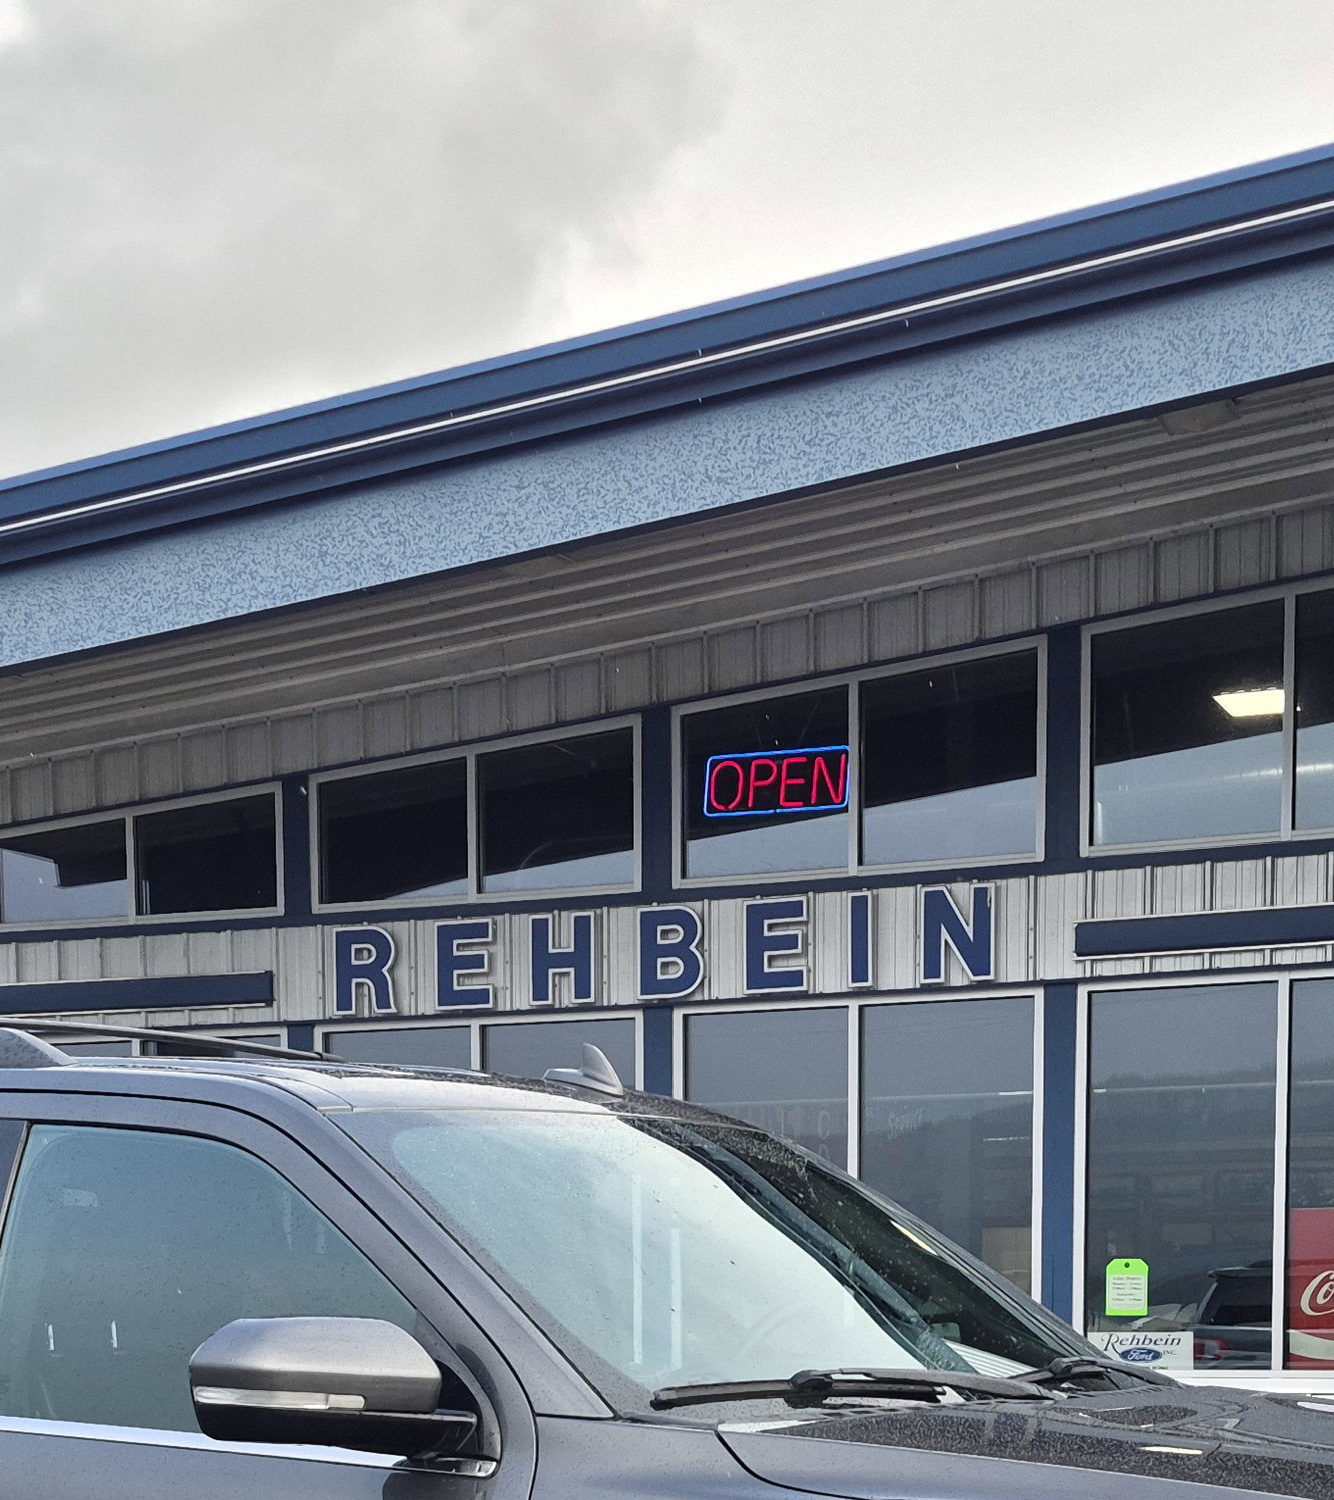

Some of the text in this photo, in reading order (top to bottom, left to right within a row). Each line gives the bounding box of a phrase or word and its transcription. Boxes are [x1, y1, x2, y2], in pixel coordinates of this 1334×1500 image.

[708, 754, 848, 811] OPEN
[333, 881, 996, 1016] REHBEIN
[1100, 1333, 1182, 1355] Rehbein
[1127, 1349, 1154, 1361] Ford
